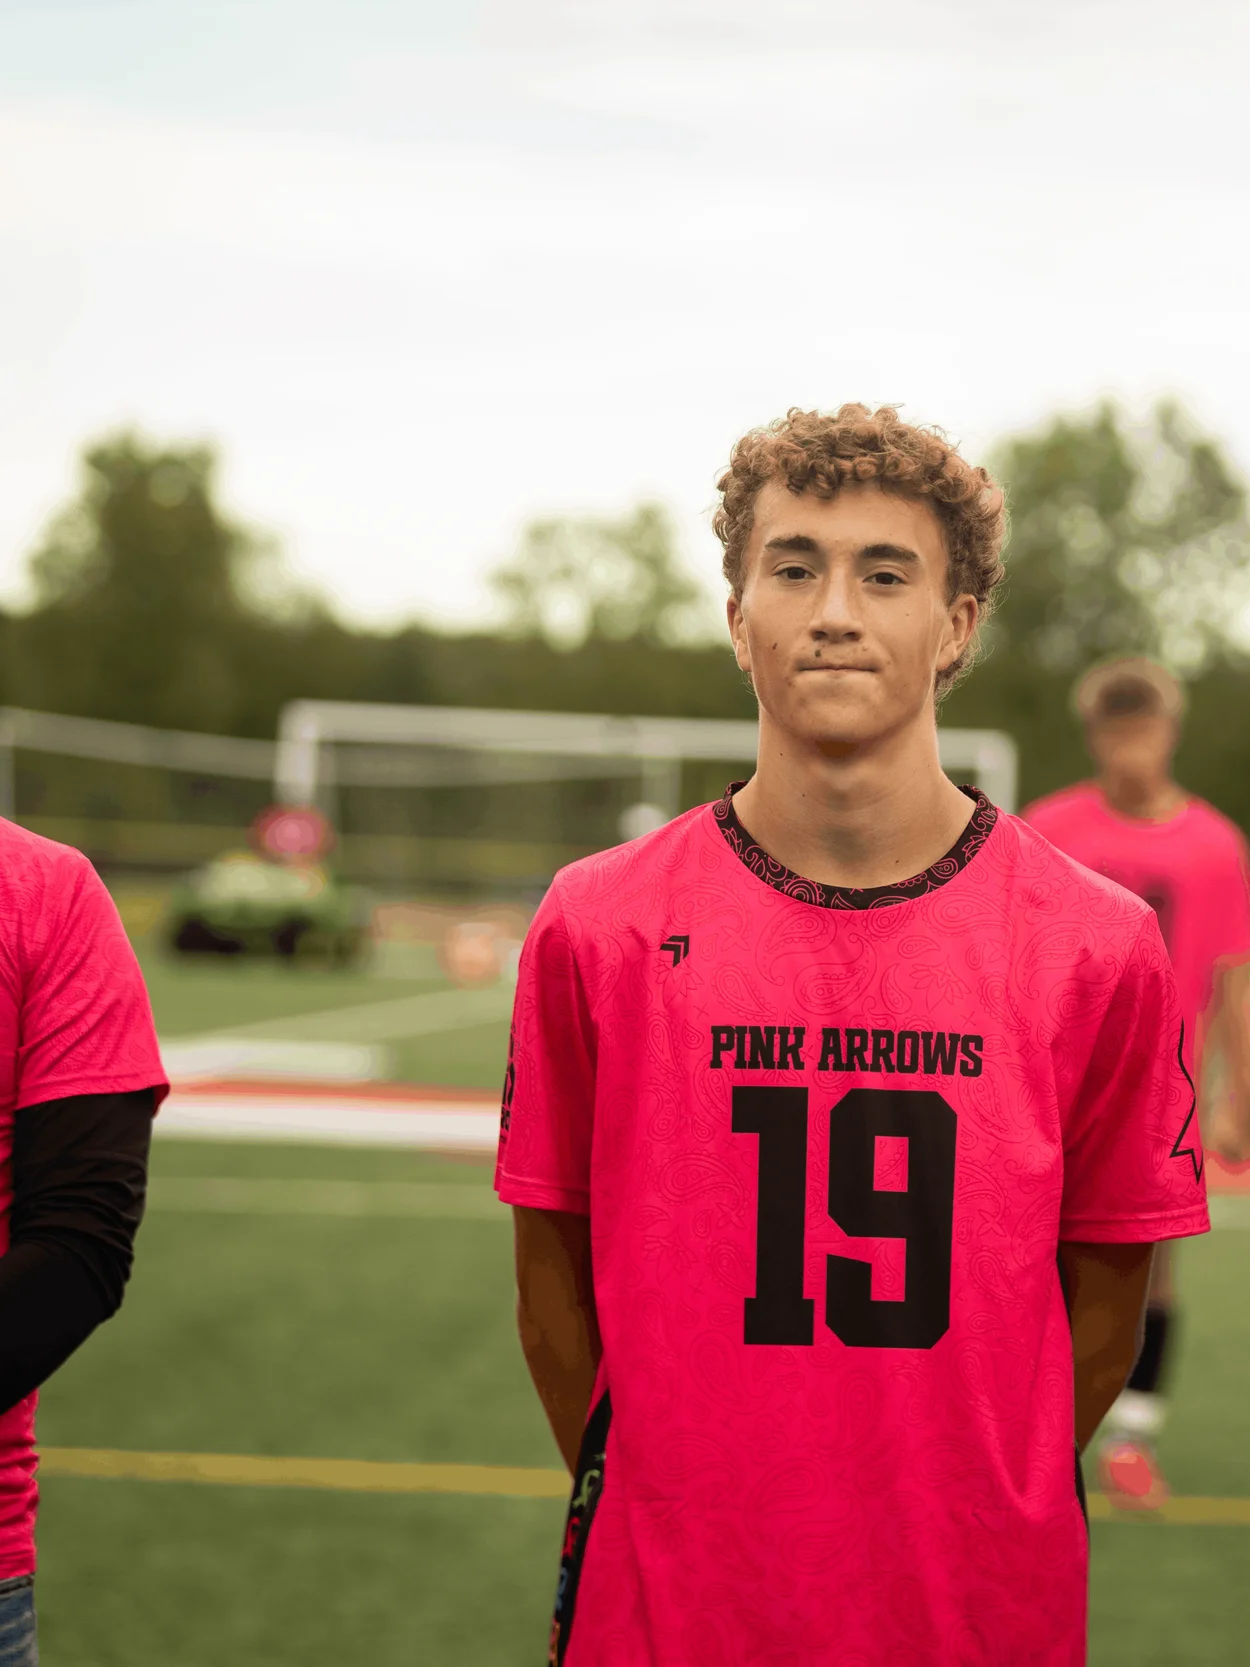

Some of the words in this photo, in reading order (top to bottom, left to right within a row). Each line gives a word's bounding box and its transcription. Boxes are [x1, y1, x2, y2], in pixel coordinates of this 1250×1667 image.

[710, 1026, 805, 1070] PINK
[817, 1027, 984, 1077] ARROWS
[732, 1085, 958, 1349] 19
